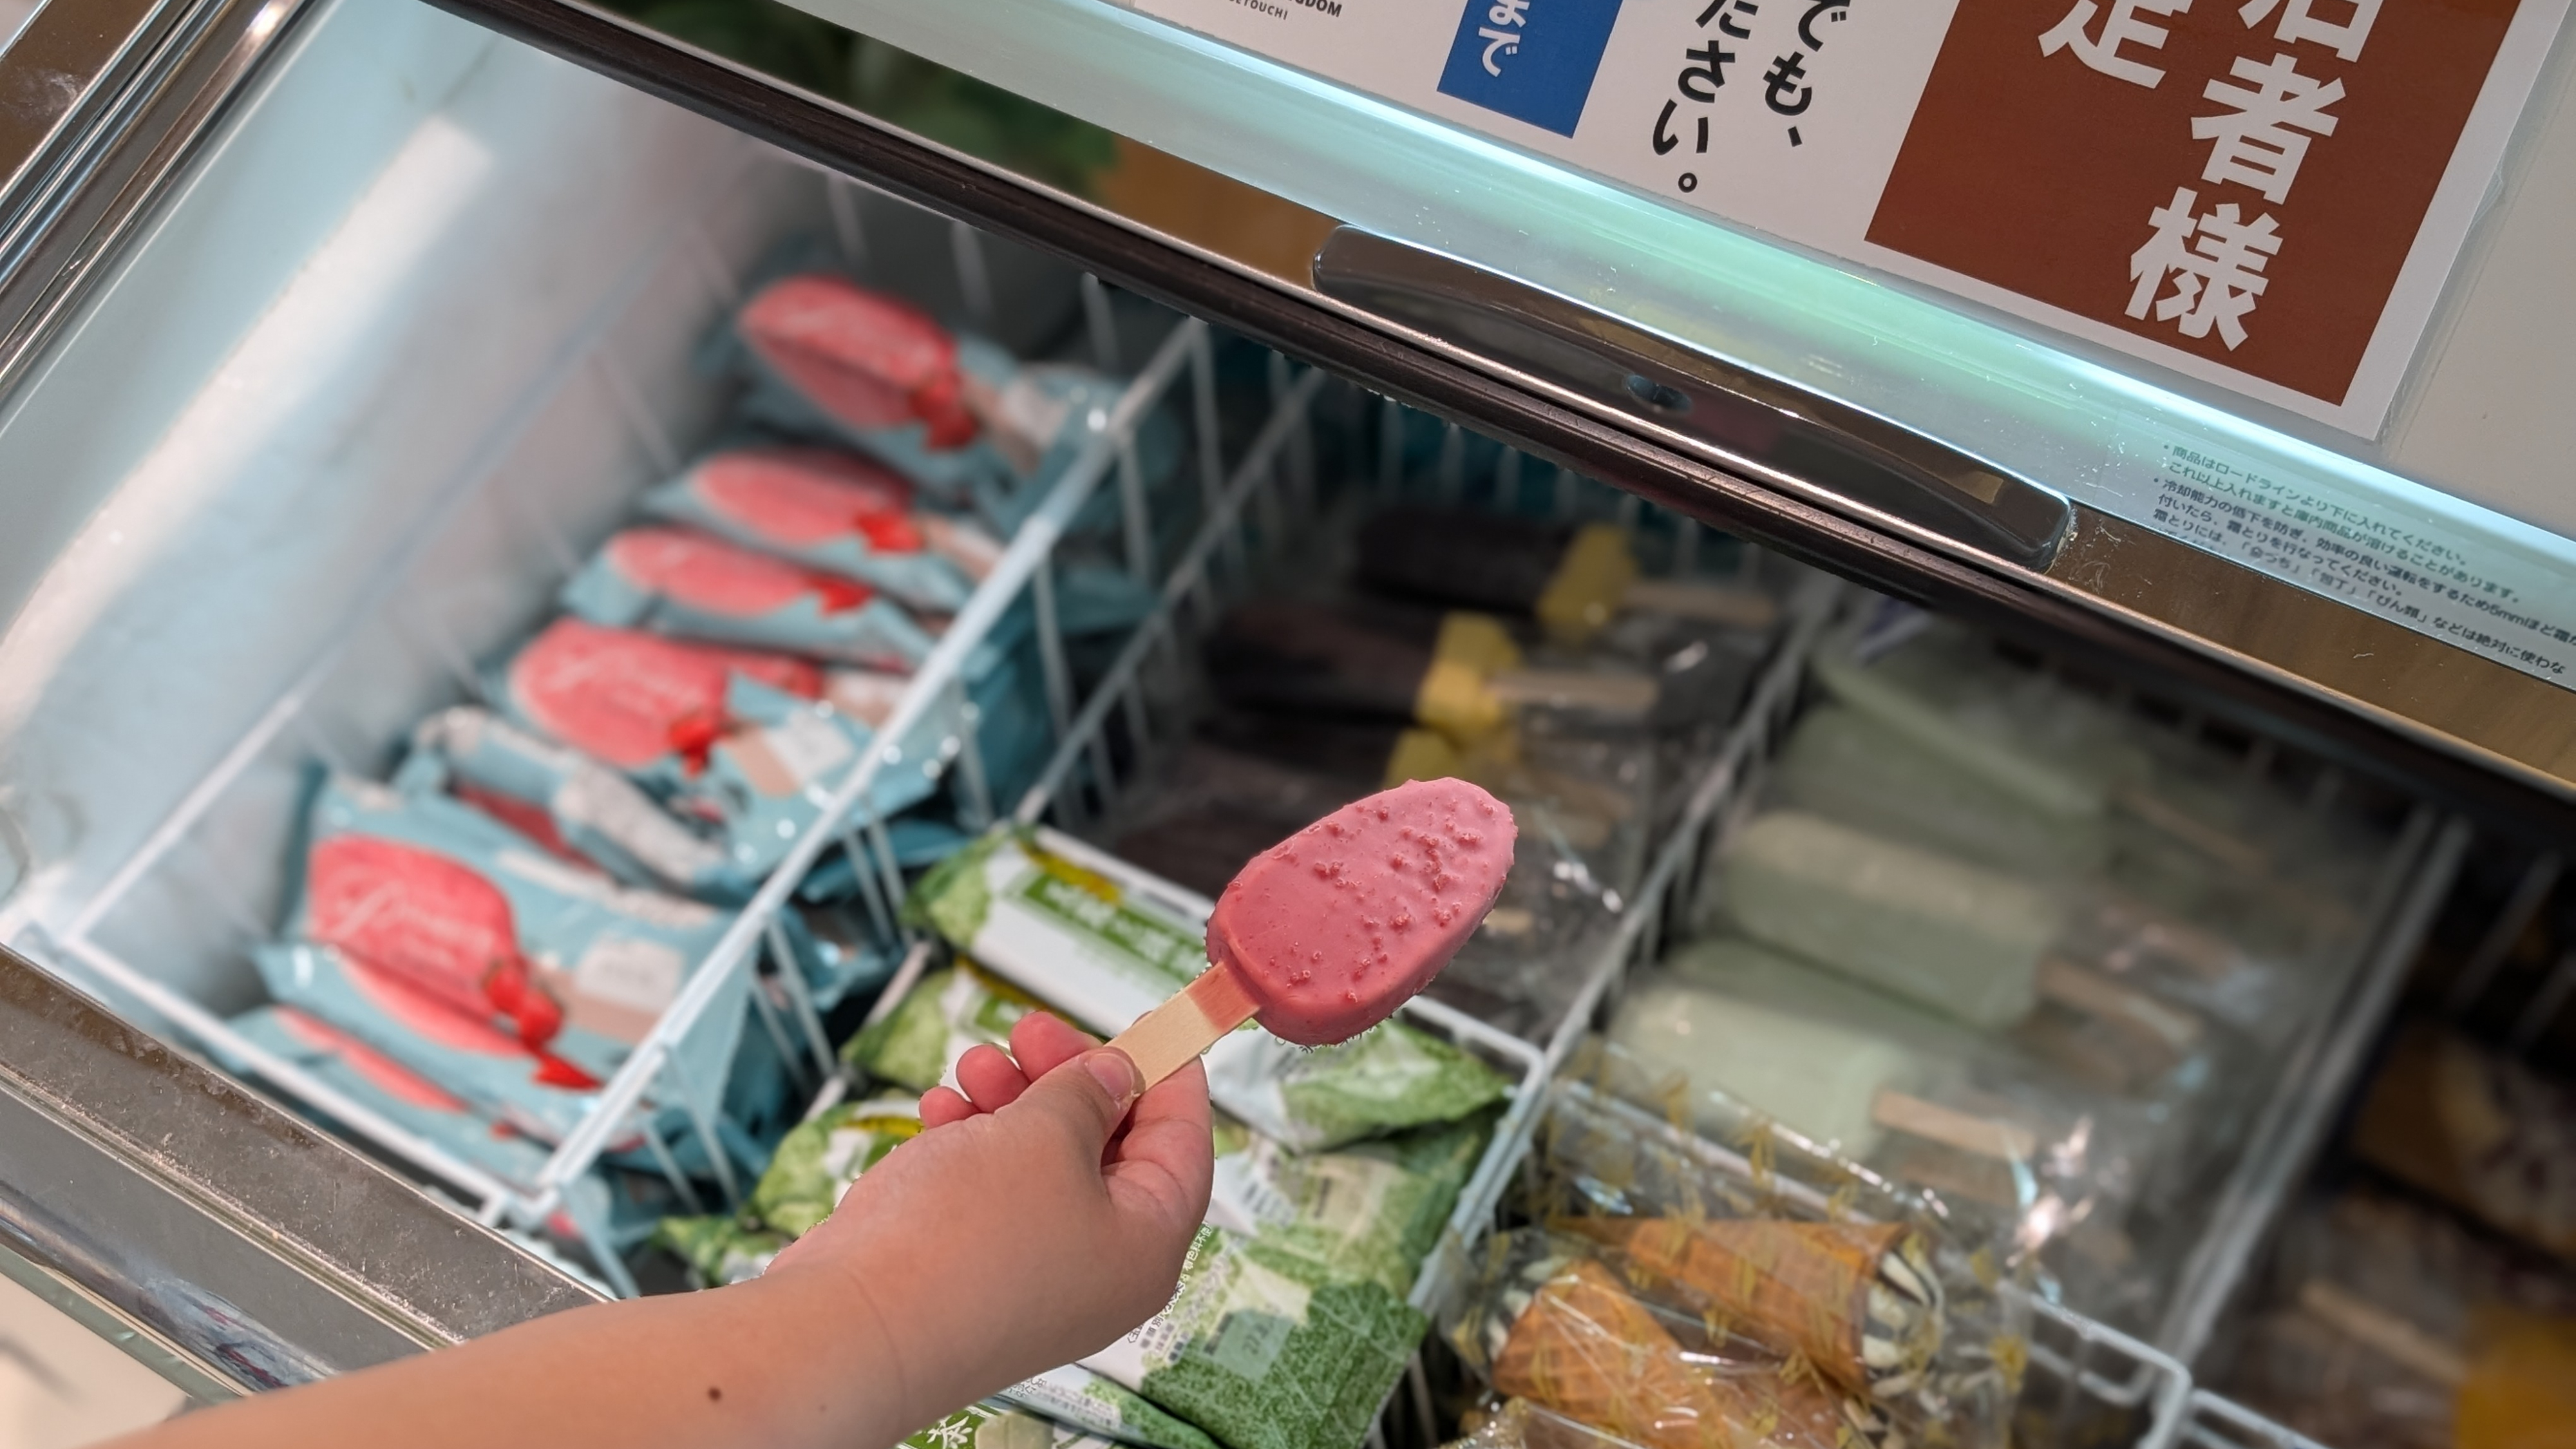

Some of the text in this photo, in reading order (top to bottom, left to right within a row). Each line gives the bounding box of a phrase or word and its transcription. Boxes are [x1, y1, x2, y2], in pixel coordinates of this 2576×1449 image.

[1763, 0, 1851, 147] でも、
[2172, 446, 2467, 565] 商品はロードラインより下に入れてください。
